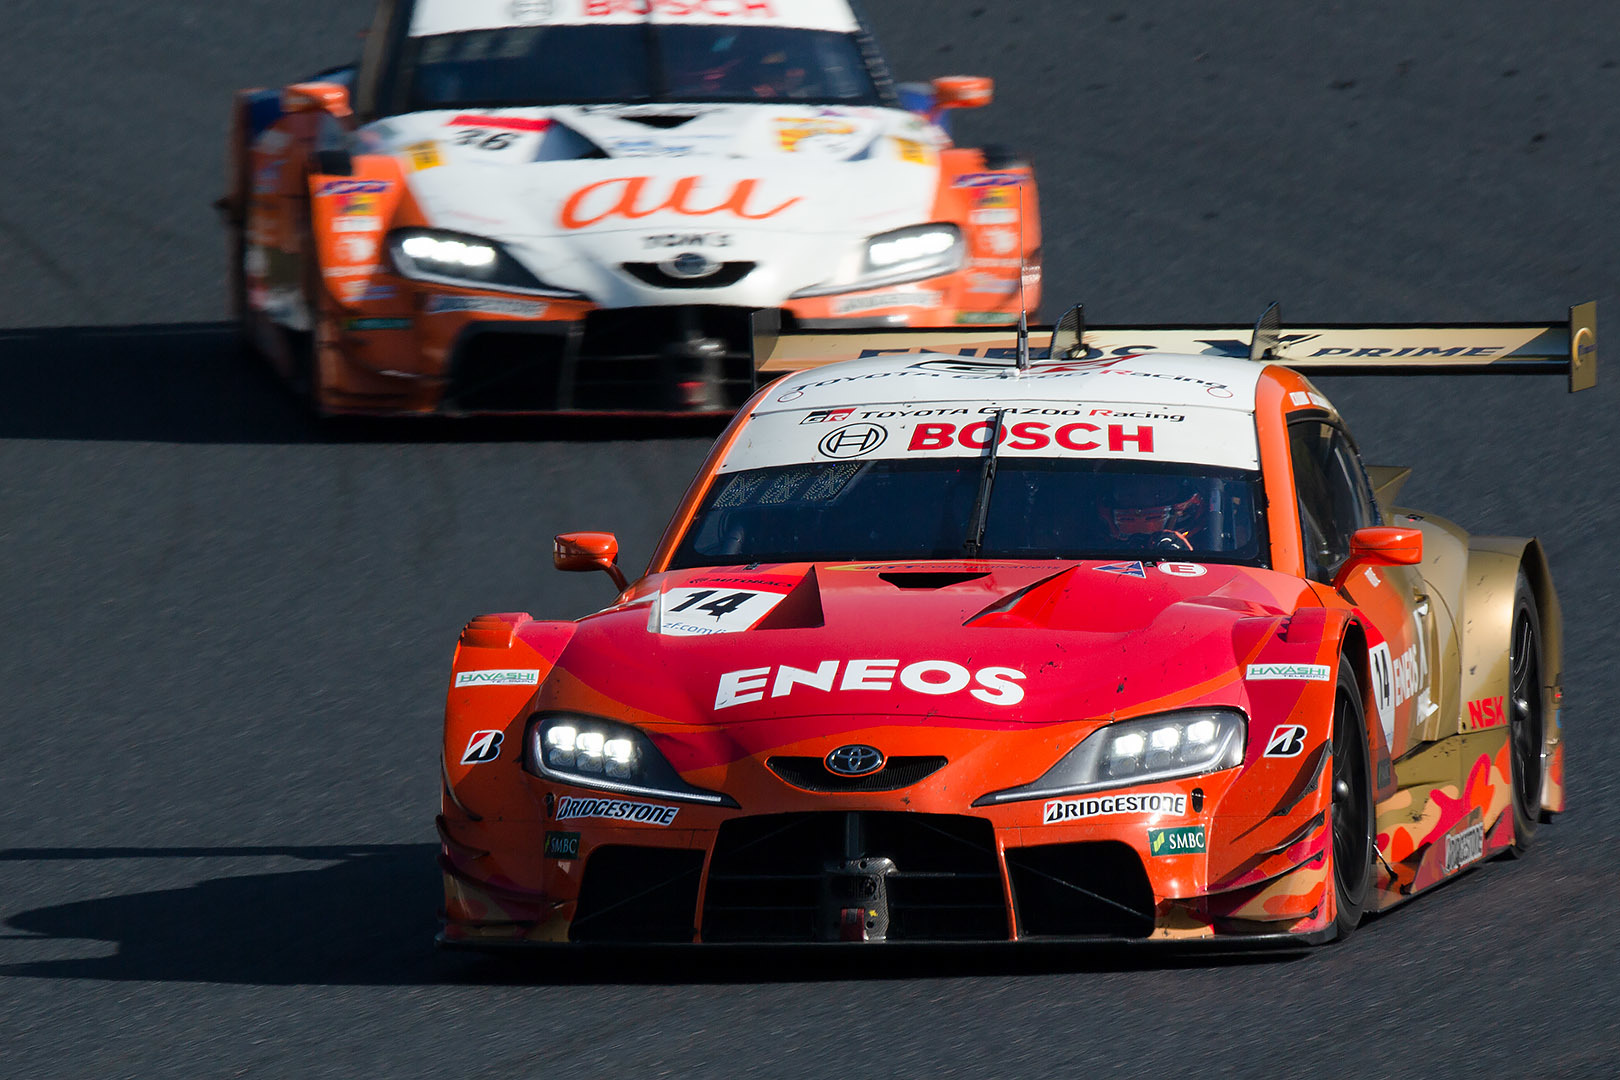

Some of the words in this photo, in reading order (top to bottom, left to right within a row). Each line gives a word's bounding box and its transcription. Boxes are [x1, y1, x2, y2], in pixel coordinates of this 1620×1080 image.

[556, 176, 804, 229] au
[1308, 346, 1505, 357] PRIME
[791, 371, 941, 392] TOYOTA
[1100, 369, 1229, 391] Racing
[860, 408, 969, 419] TOYOTA
[977, 406, 1081, 417] GAZOO
[1088, 408, 1186, 423] Racing
[908, 421, 1155, 453] BOSCH
[668, 590, 759, 618] 14
[460, 672, 537, 682] HAYASHI
[714, 659, 1027, 711] ENEOS
[1251, 666, 1326, 676] HAYASHI
[1374, 649, 1391, 711] 14
[1392, 643, 1420, 708] ENEOS
[1467, 695, 1507, 730] NSK
[556, 797, 680, 826] BRIDGESTONE
[1044, 794, 1187, 824] BRIDGESTONE
[551, 837, 578, 854] SMBC
[1169, 831, 1205, 850] SMBC
